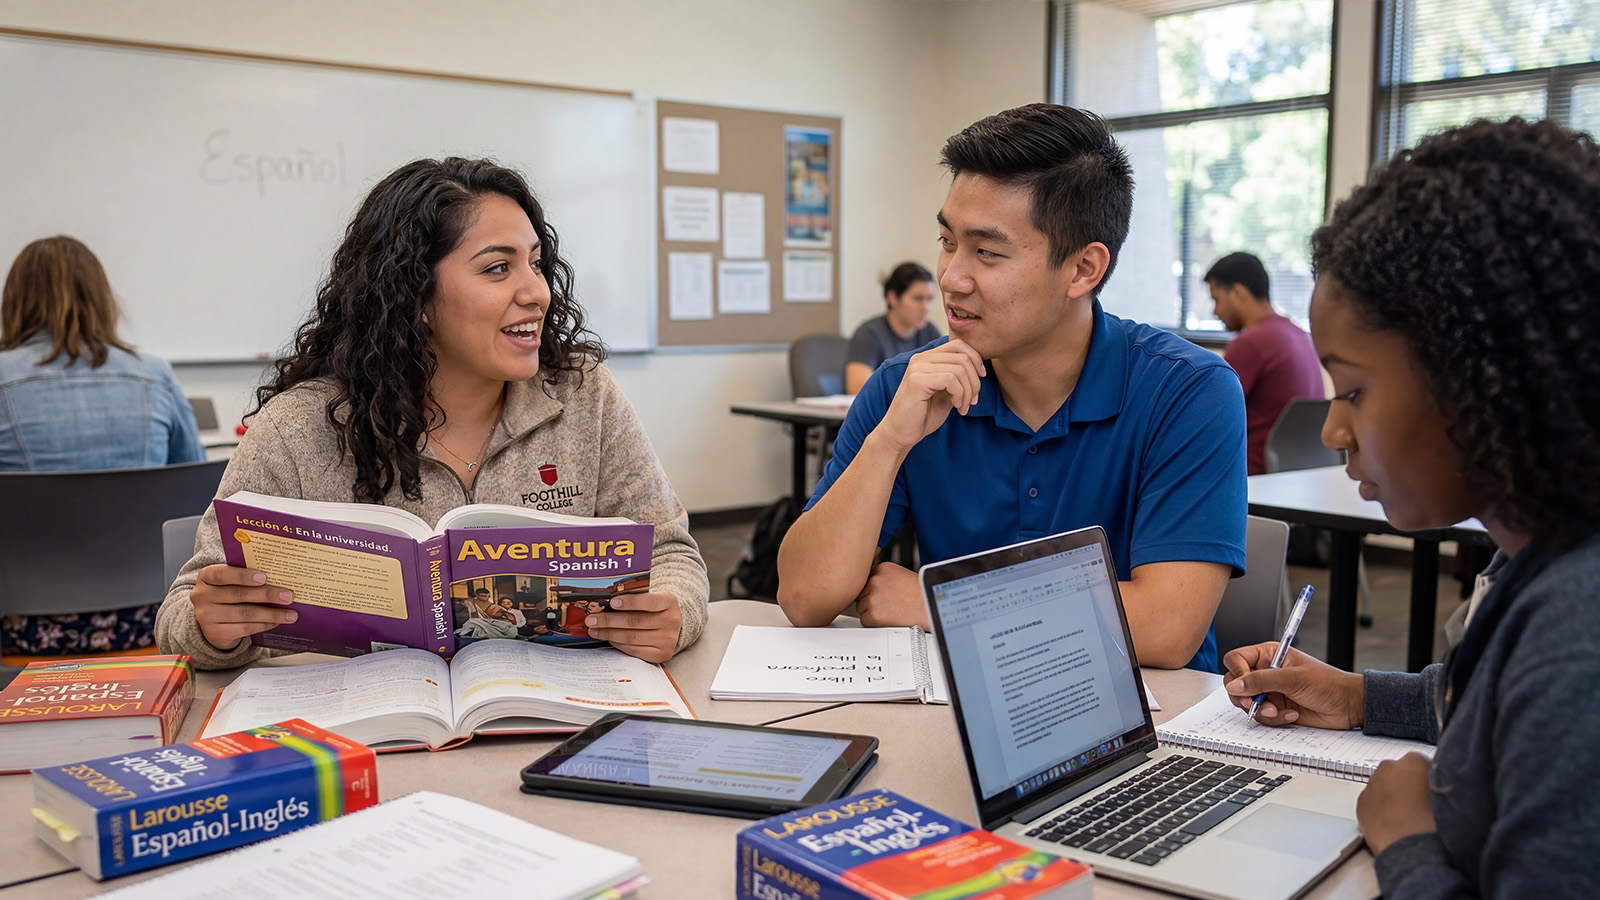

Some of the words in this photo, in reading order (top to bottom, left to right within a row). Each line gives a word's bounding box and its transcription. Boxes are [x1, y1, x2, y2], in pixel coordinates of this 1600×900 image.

[199, 127, 347, 199] Español
[521, 485, 583, 504] FOOTHILL
[536, 499, 573, 511] COLLEGE
[236, 515, 280, 531] Lección
[282, 525, 293, 533] 4:
[295, 527, 310, 537] En
[312, 530, 322, 539] la
[325, 534, 392, 553] universidad.
[457, 538, 635, 561] Aventura
[429, 559, 442, 601] Aventura
[549, 558, 618, 573] Spanish
[626, 558, 632, 568] 1
[431, 601, 447, 635] Spanish
[0, 702, 142, 718] LAROUSSE
[6, 689, 145, 706] Español-
[129, 793, 229, 831] Larousse
[131, 797, 309, 858] Español-Inglés
[763, 794, 898, 840] LAROUSSE
[753, 848, 820, 900] Larousse
